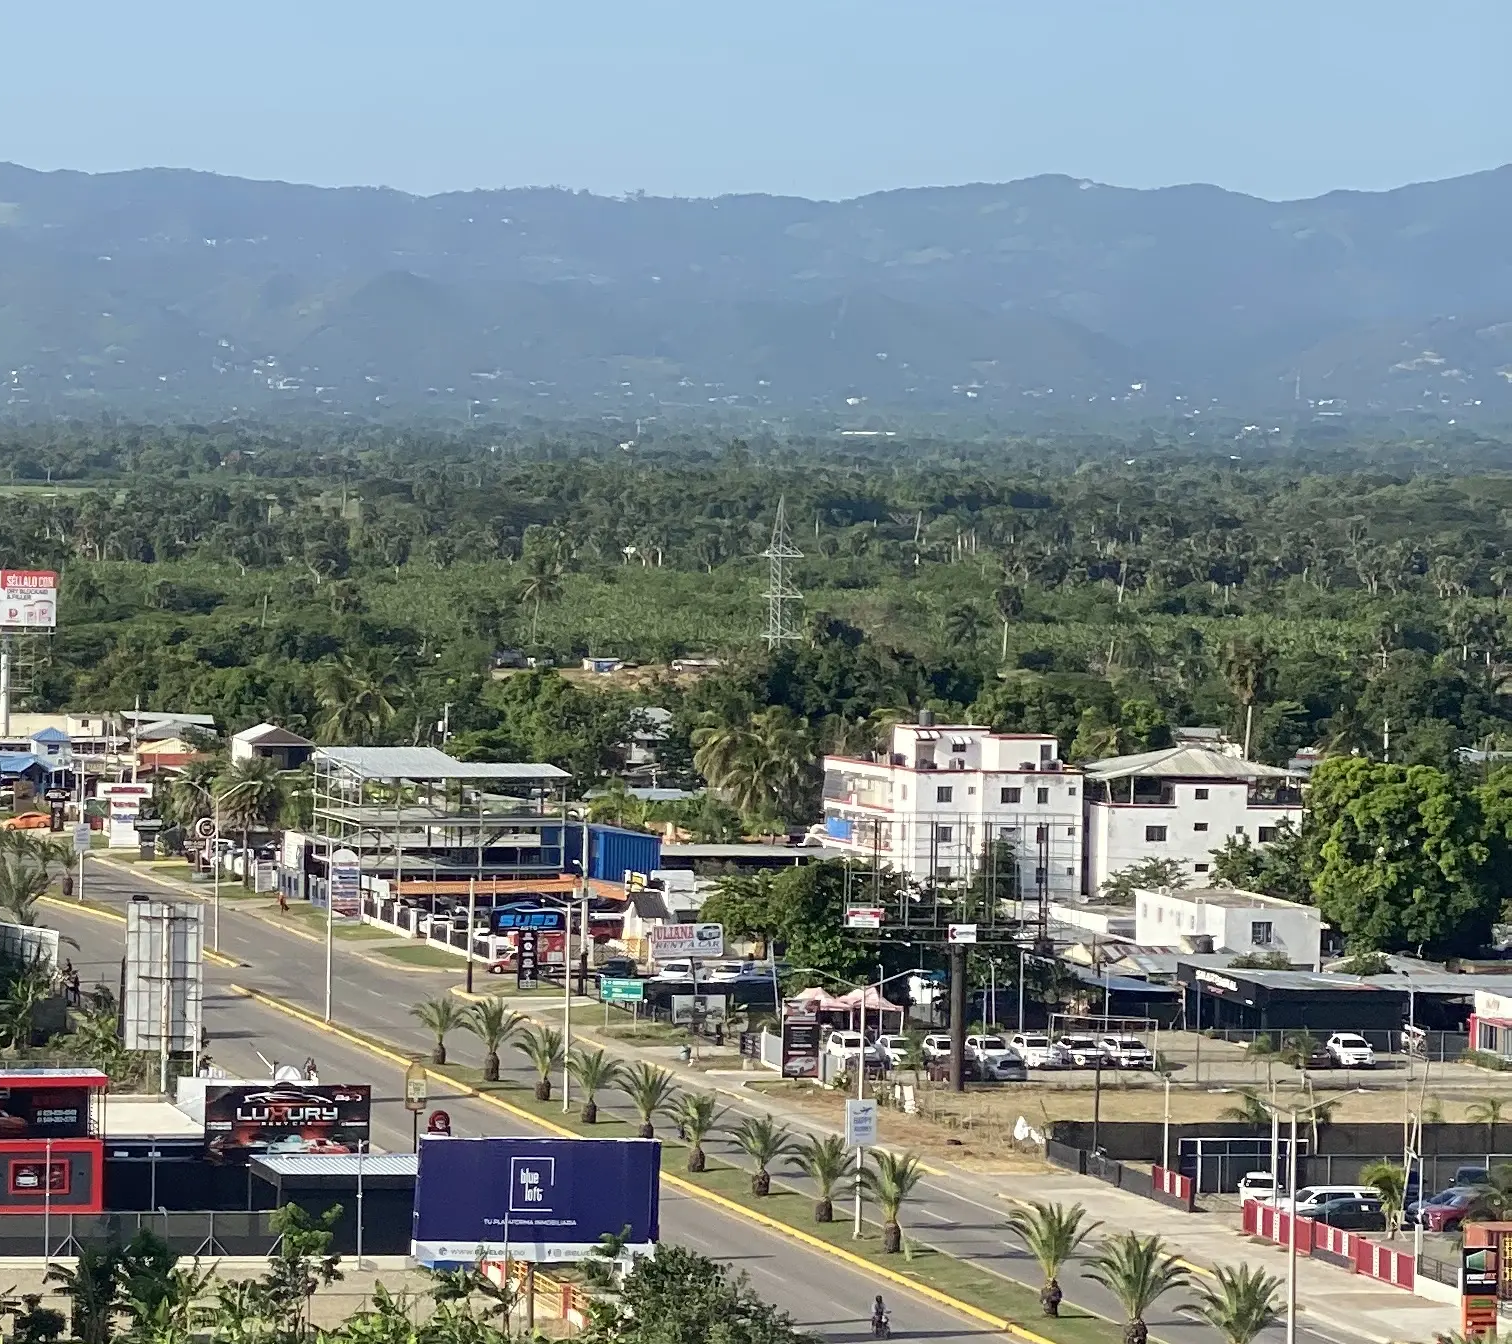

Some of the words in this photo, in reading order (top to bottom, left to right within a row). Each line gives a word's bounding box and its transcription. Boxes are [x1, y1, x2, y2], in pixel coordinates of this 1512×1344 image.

[39, 576, 54, 587] CON
[652, 926, 693, 943] JULIANA
[237, 1107, 338, 1120] LUXURY
[520, 1167, 539, 1184] blue
[525, 1183, 544, 1202] loft
